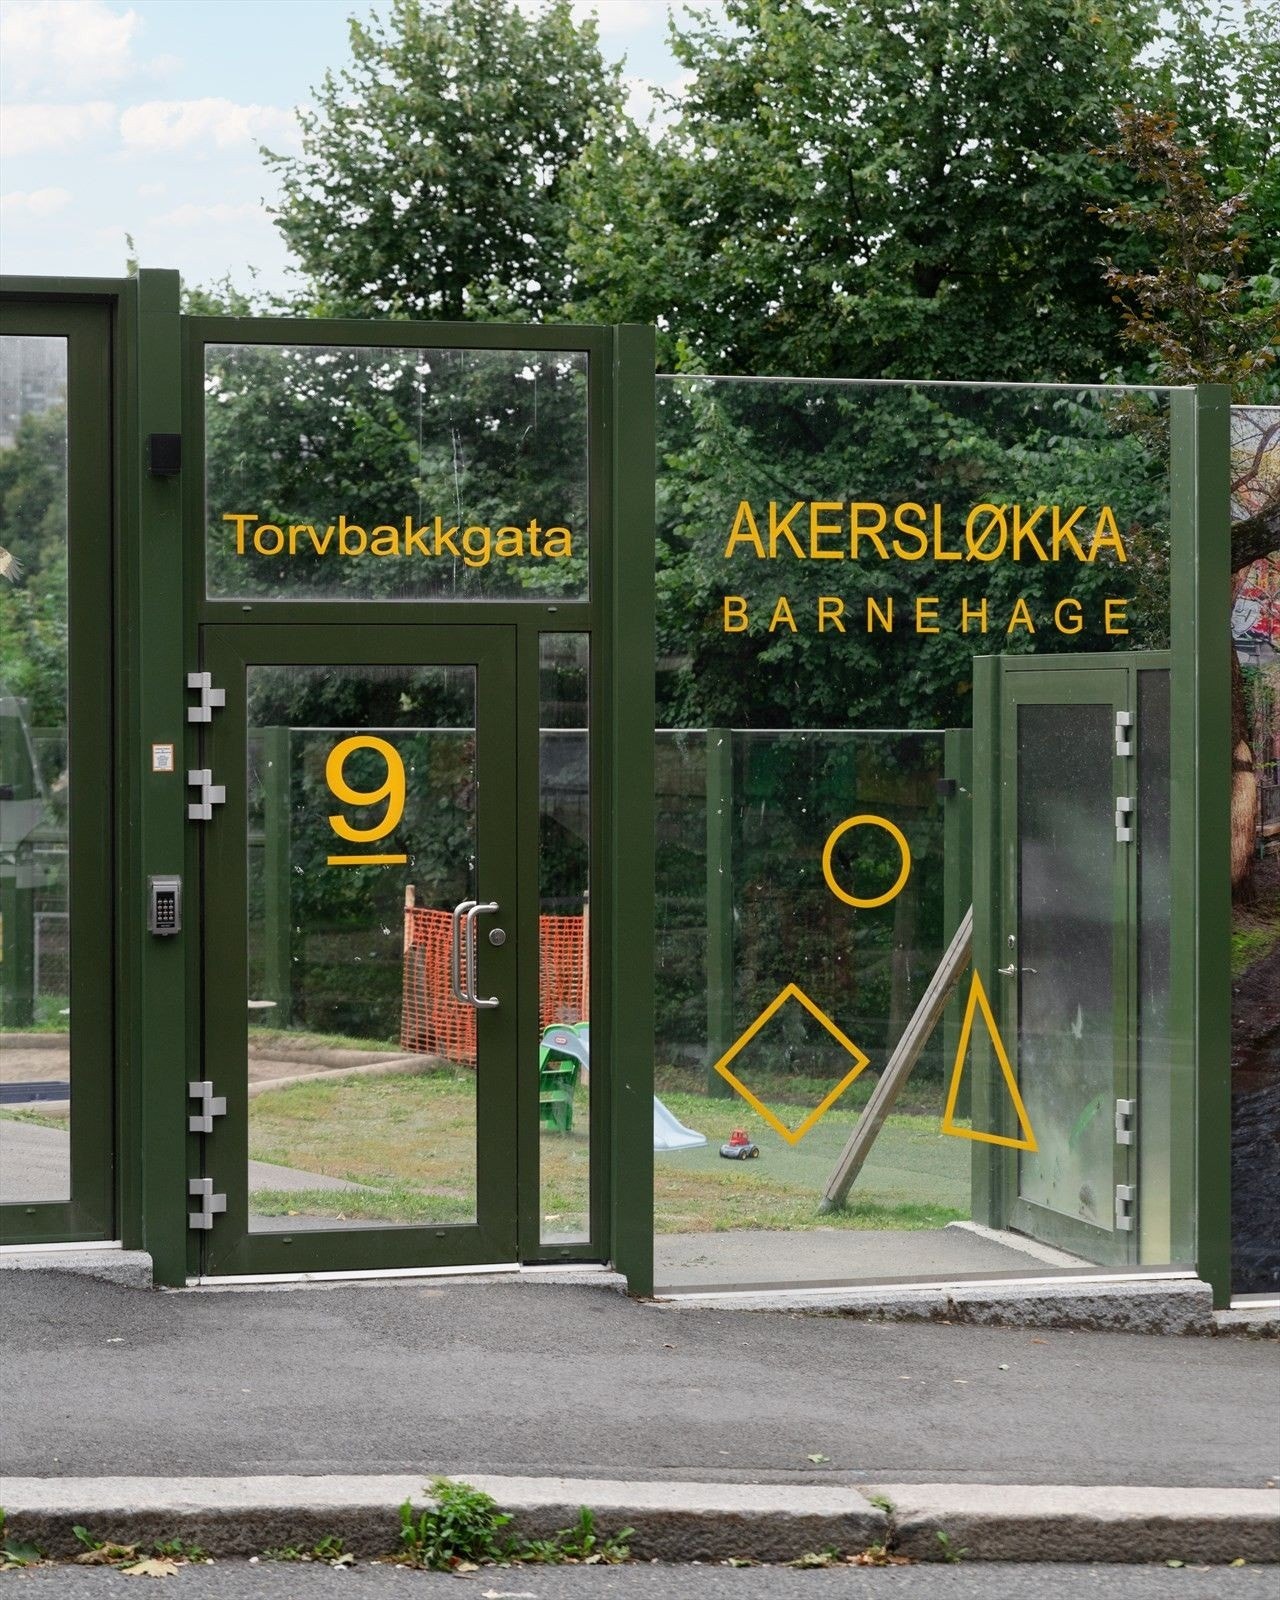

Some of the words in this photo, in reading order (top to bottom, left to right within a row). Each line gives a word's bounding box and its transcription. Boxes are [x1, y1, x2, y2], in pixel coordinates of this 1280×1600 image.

[222, 513, 573, 568] Torvbakkgata
[724, 500, 1127, 562] AKERSLØKKA
[723, 596, 1129, 635] BARNEHAGE
[325, 735, 406, 843] 9
